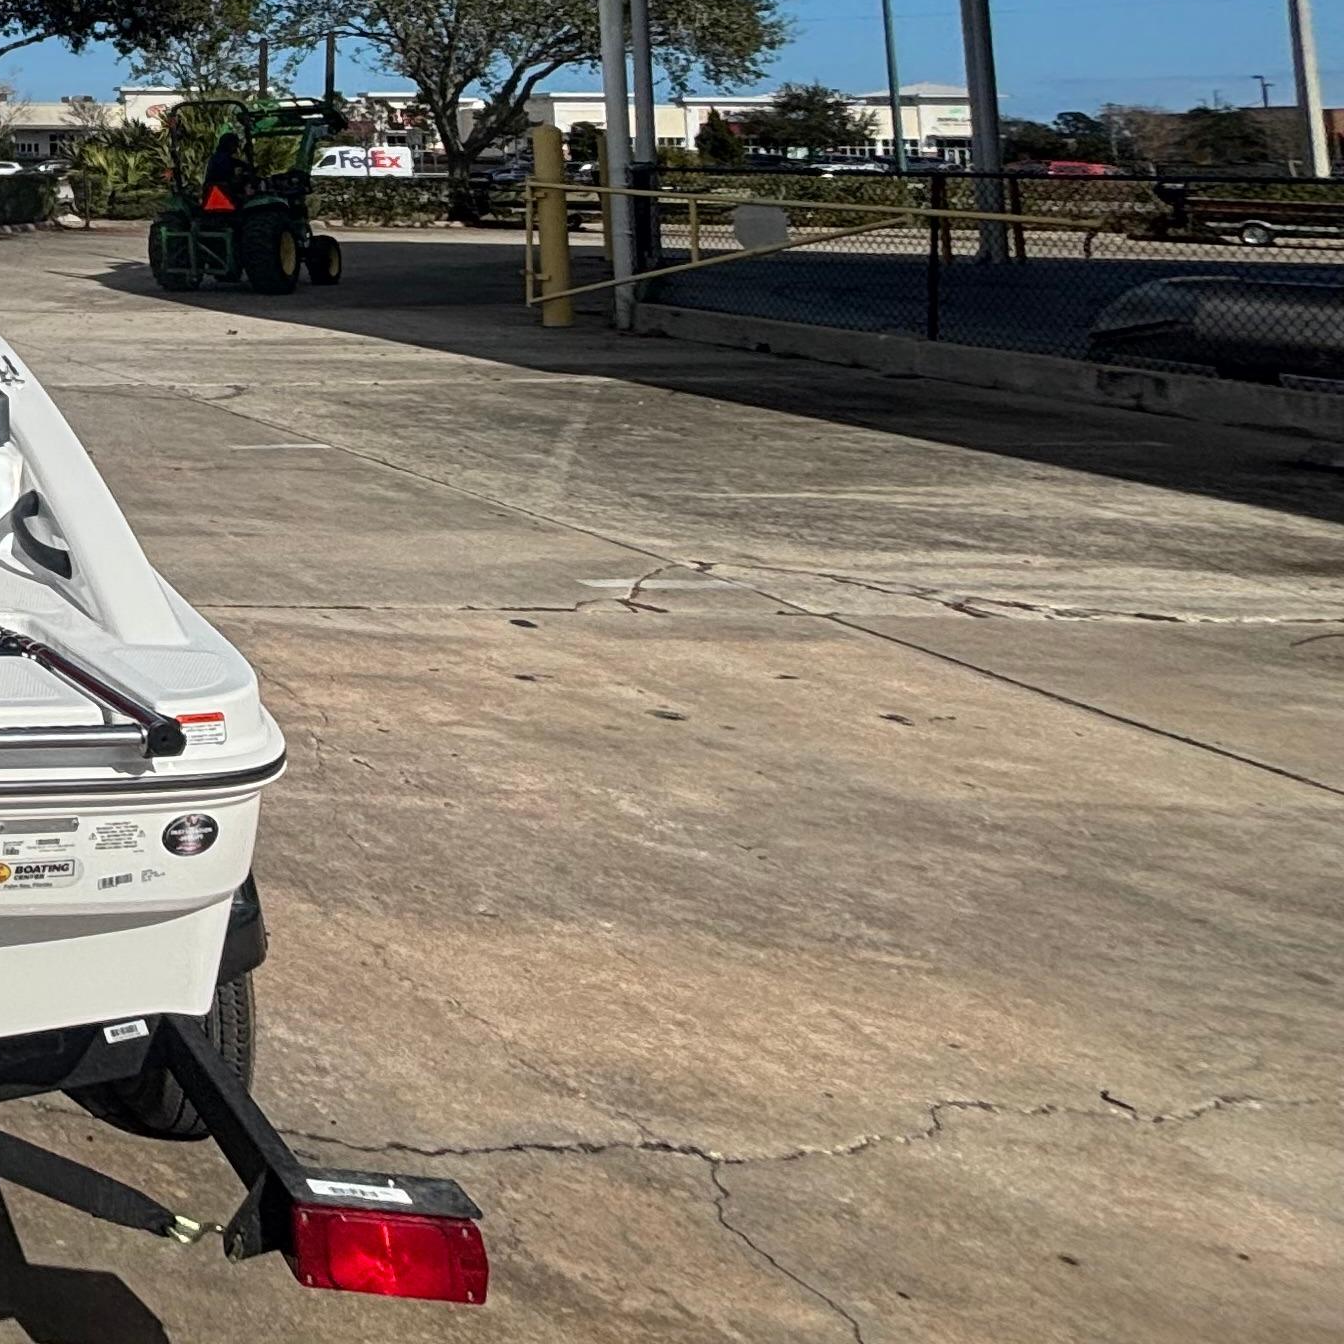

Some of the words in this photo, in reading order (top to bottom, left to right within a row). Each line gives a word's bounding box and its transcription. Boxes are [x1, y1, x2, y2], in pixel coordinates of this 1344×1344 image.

[338, 150, 403, 169] FedEx
[14, 863, 70, 874] BOATING
[13, 873, 45, 881] CENTER
